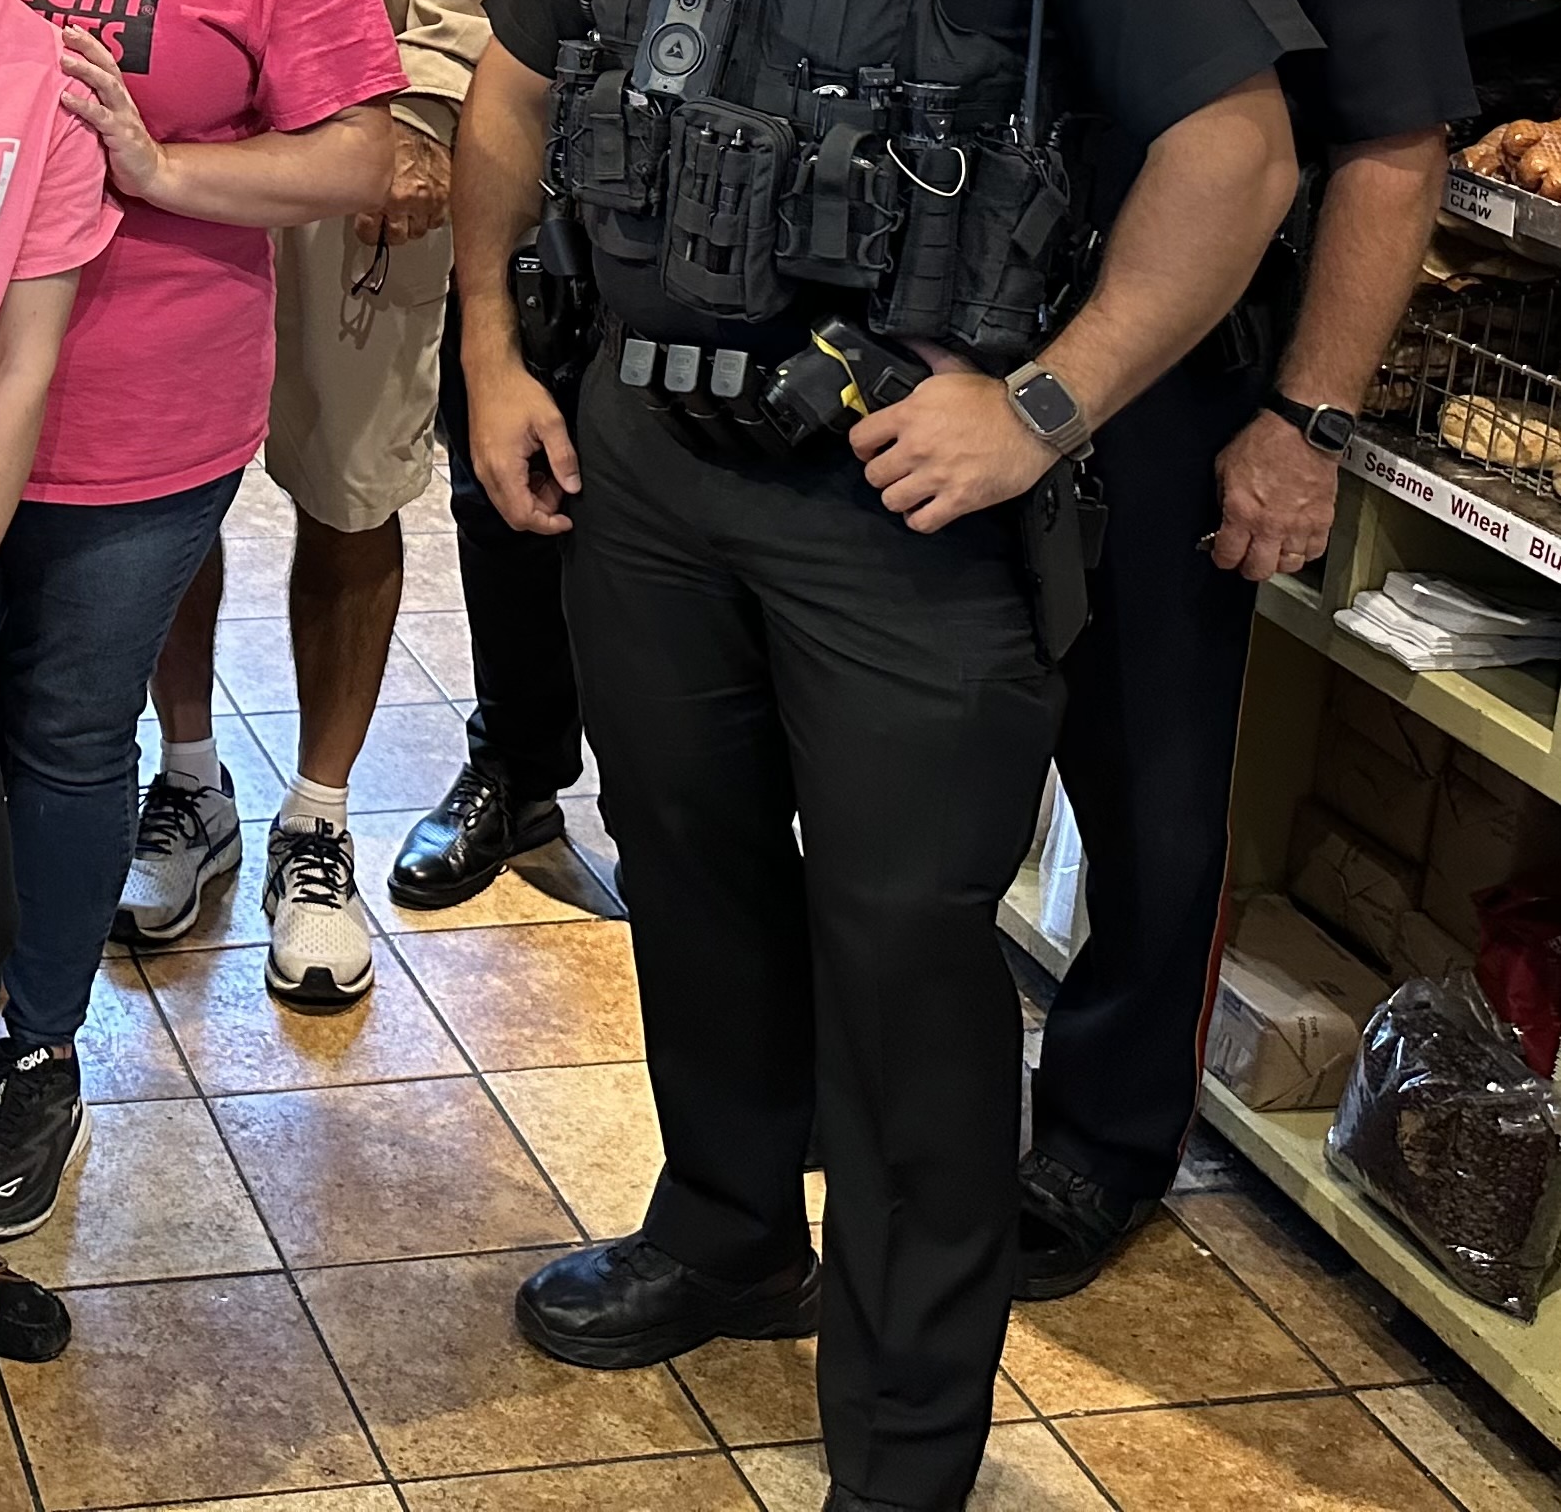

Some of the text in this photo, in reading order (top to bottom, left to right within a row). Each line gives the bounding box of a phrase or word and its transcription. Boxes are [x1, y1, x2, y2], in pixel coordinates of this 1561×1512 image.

[1450, 178, 1489, 203] BEAR
[1450, 194, 1492, 220] CLAW
[1364, 451, 1561, 571] Sesame Wheat Blu
